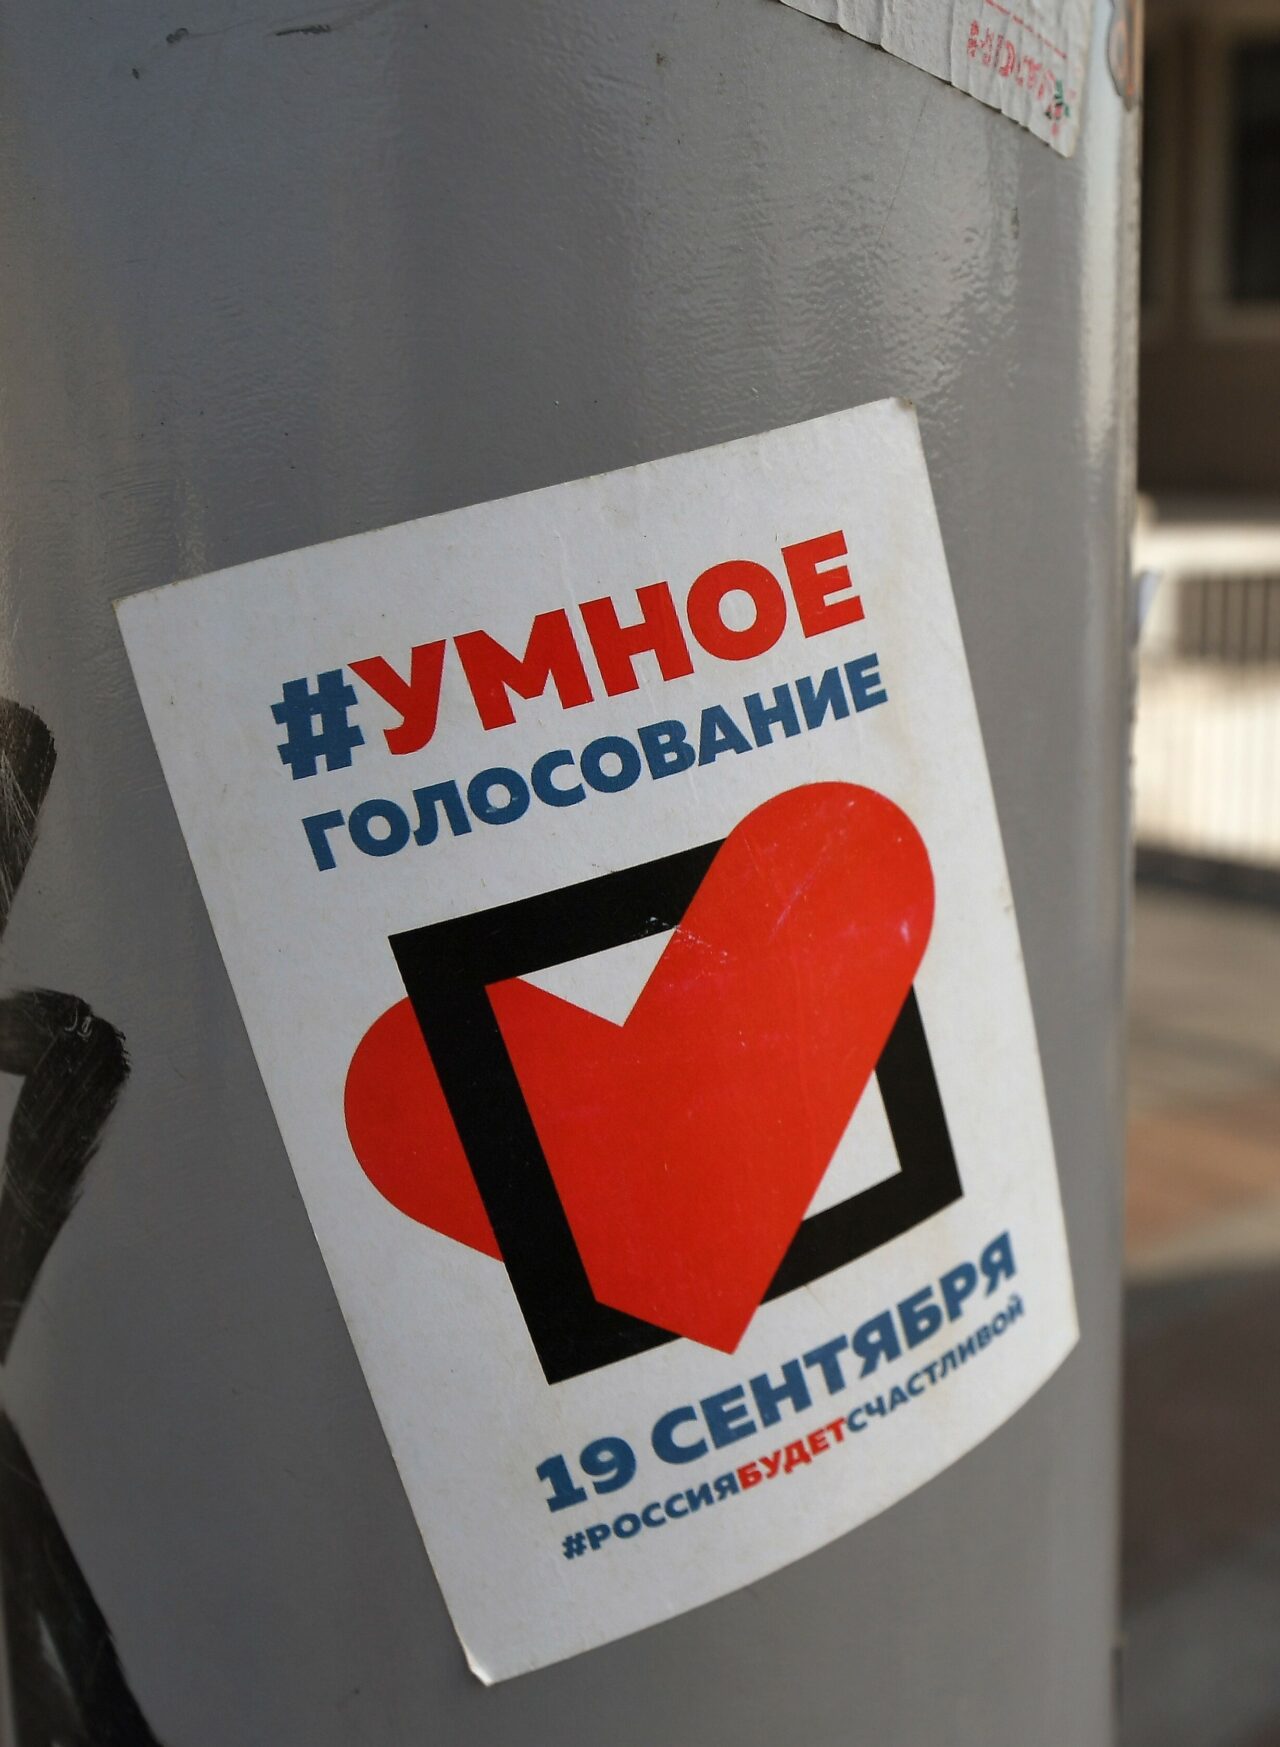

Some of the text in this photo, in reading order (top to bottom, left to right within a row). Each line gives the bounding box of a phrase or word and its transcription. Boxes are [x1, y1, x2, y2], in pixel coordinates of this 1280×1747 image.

[270, 530, 865, 780] #УМНОЕ
[301, 653, 888, 871] ГОЛОСОВАНИЕ
[535, 1230, 1017, 1513] 19 СЕНТЯБРЯ
[562, 1294, 1025, 1560] #РОССИЯБУДЕТСЧАСТЛИВОЙ
